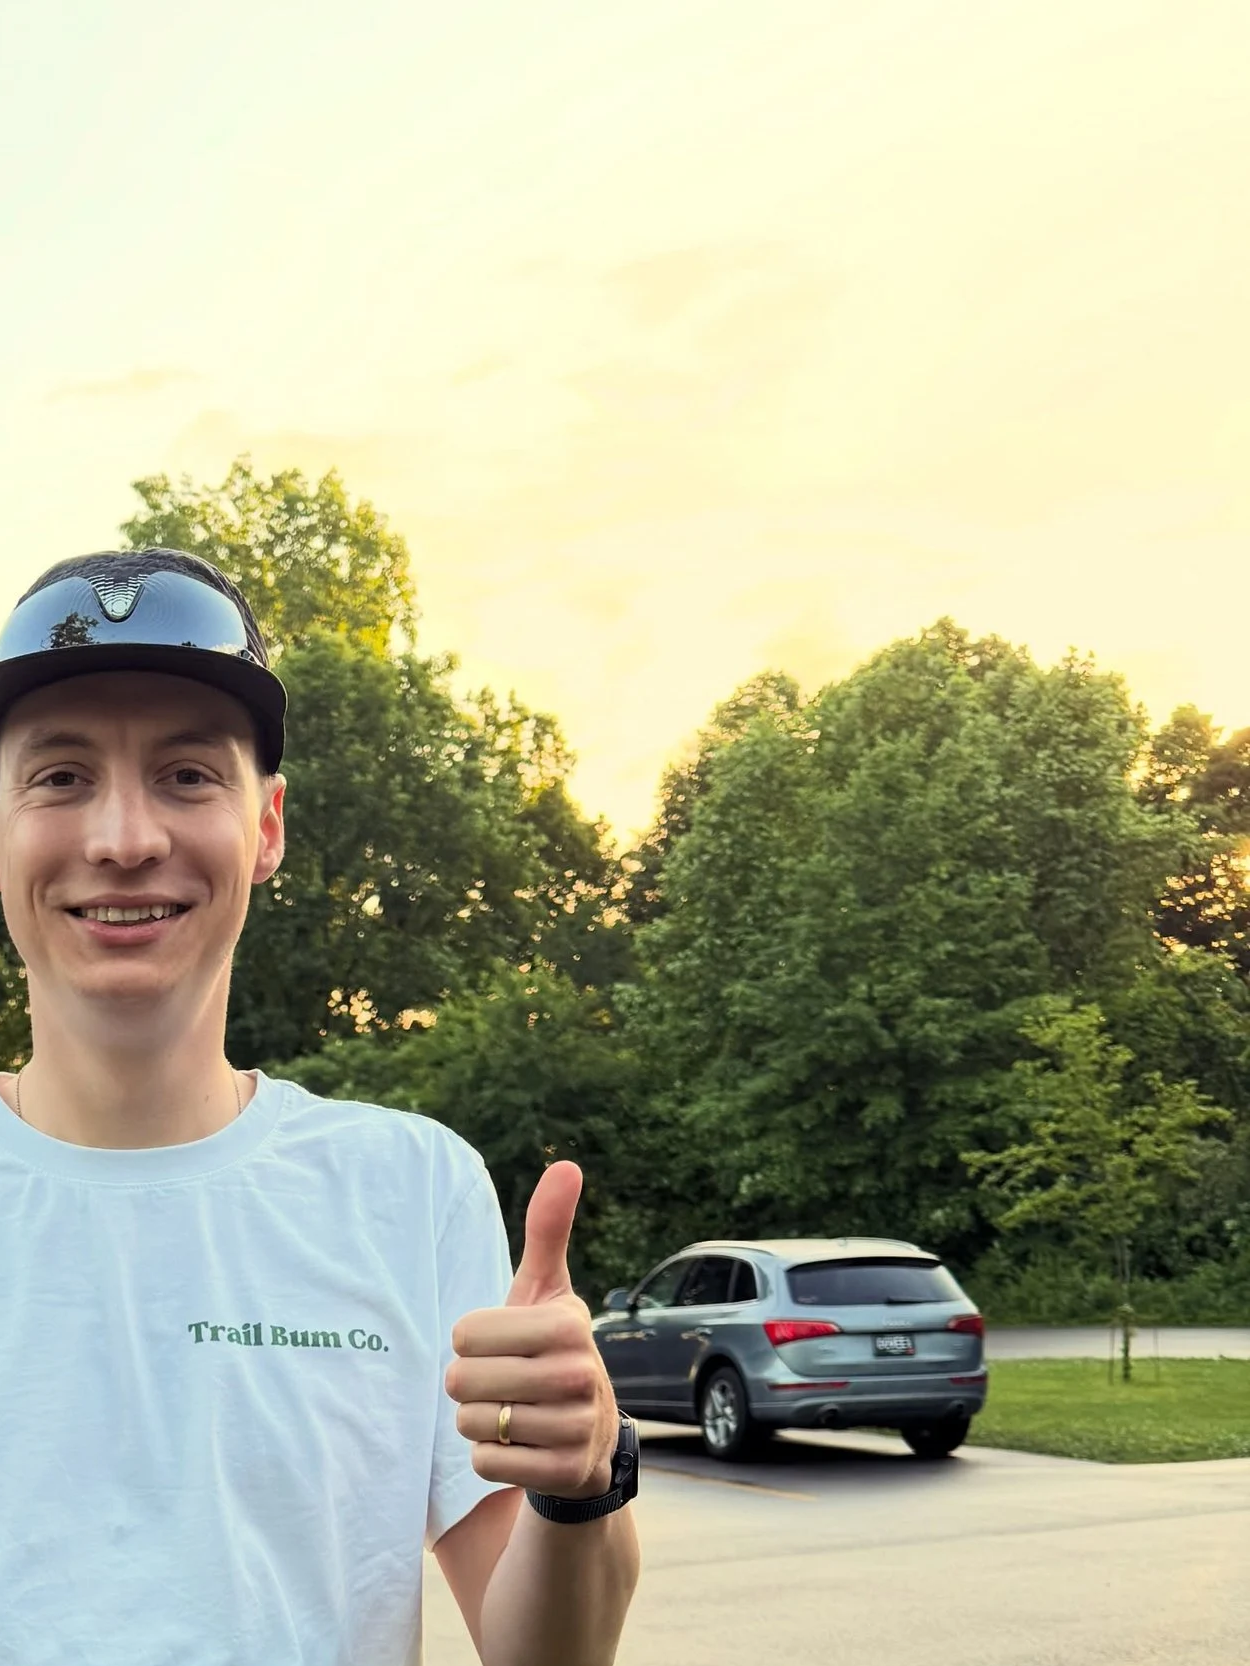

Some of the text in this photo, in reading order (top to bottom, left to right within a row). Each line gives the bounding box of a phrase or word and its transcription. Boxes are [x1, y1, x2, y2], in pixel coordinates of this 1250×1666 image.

[187, 1321, 389, 1352] Trail Bum Co.
